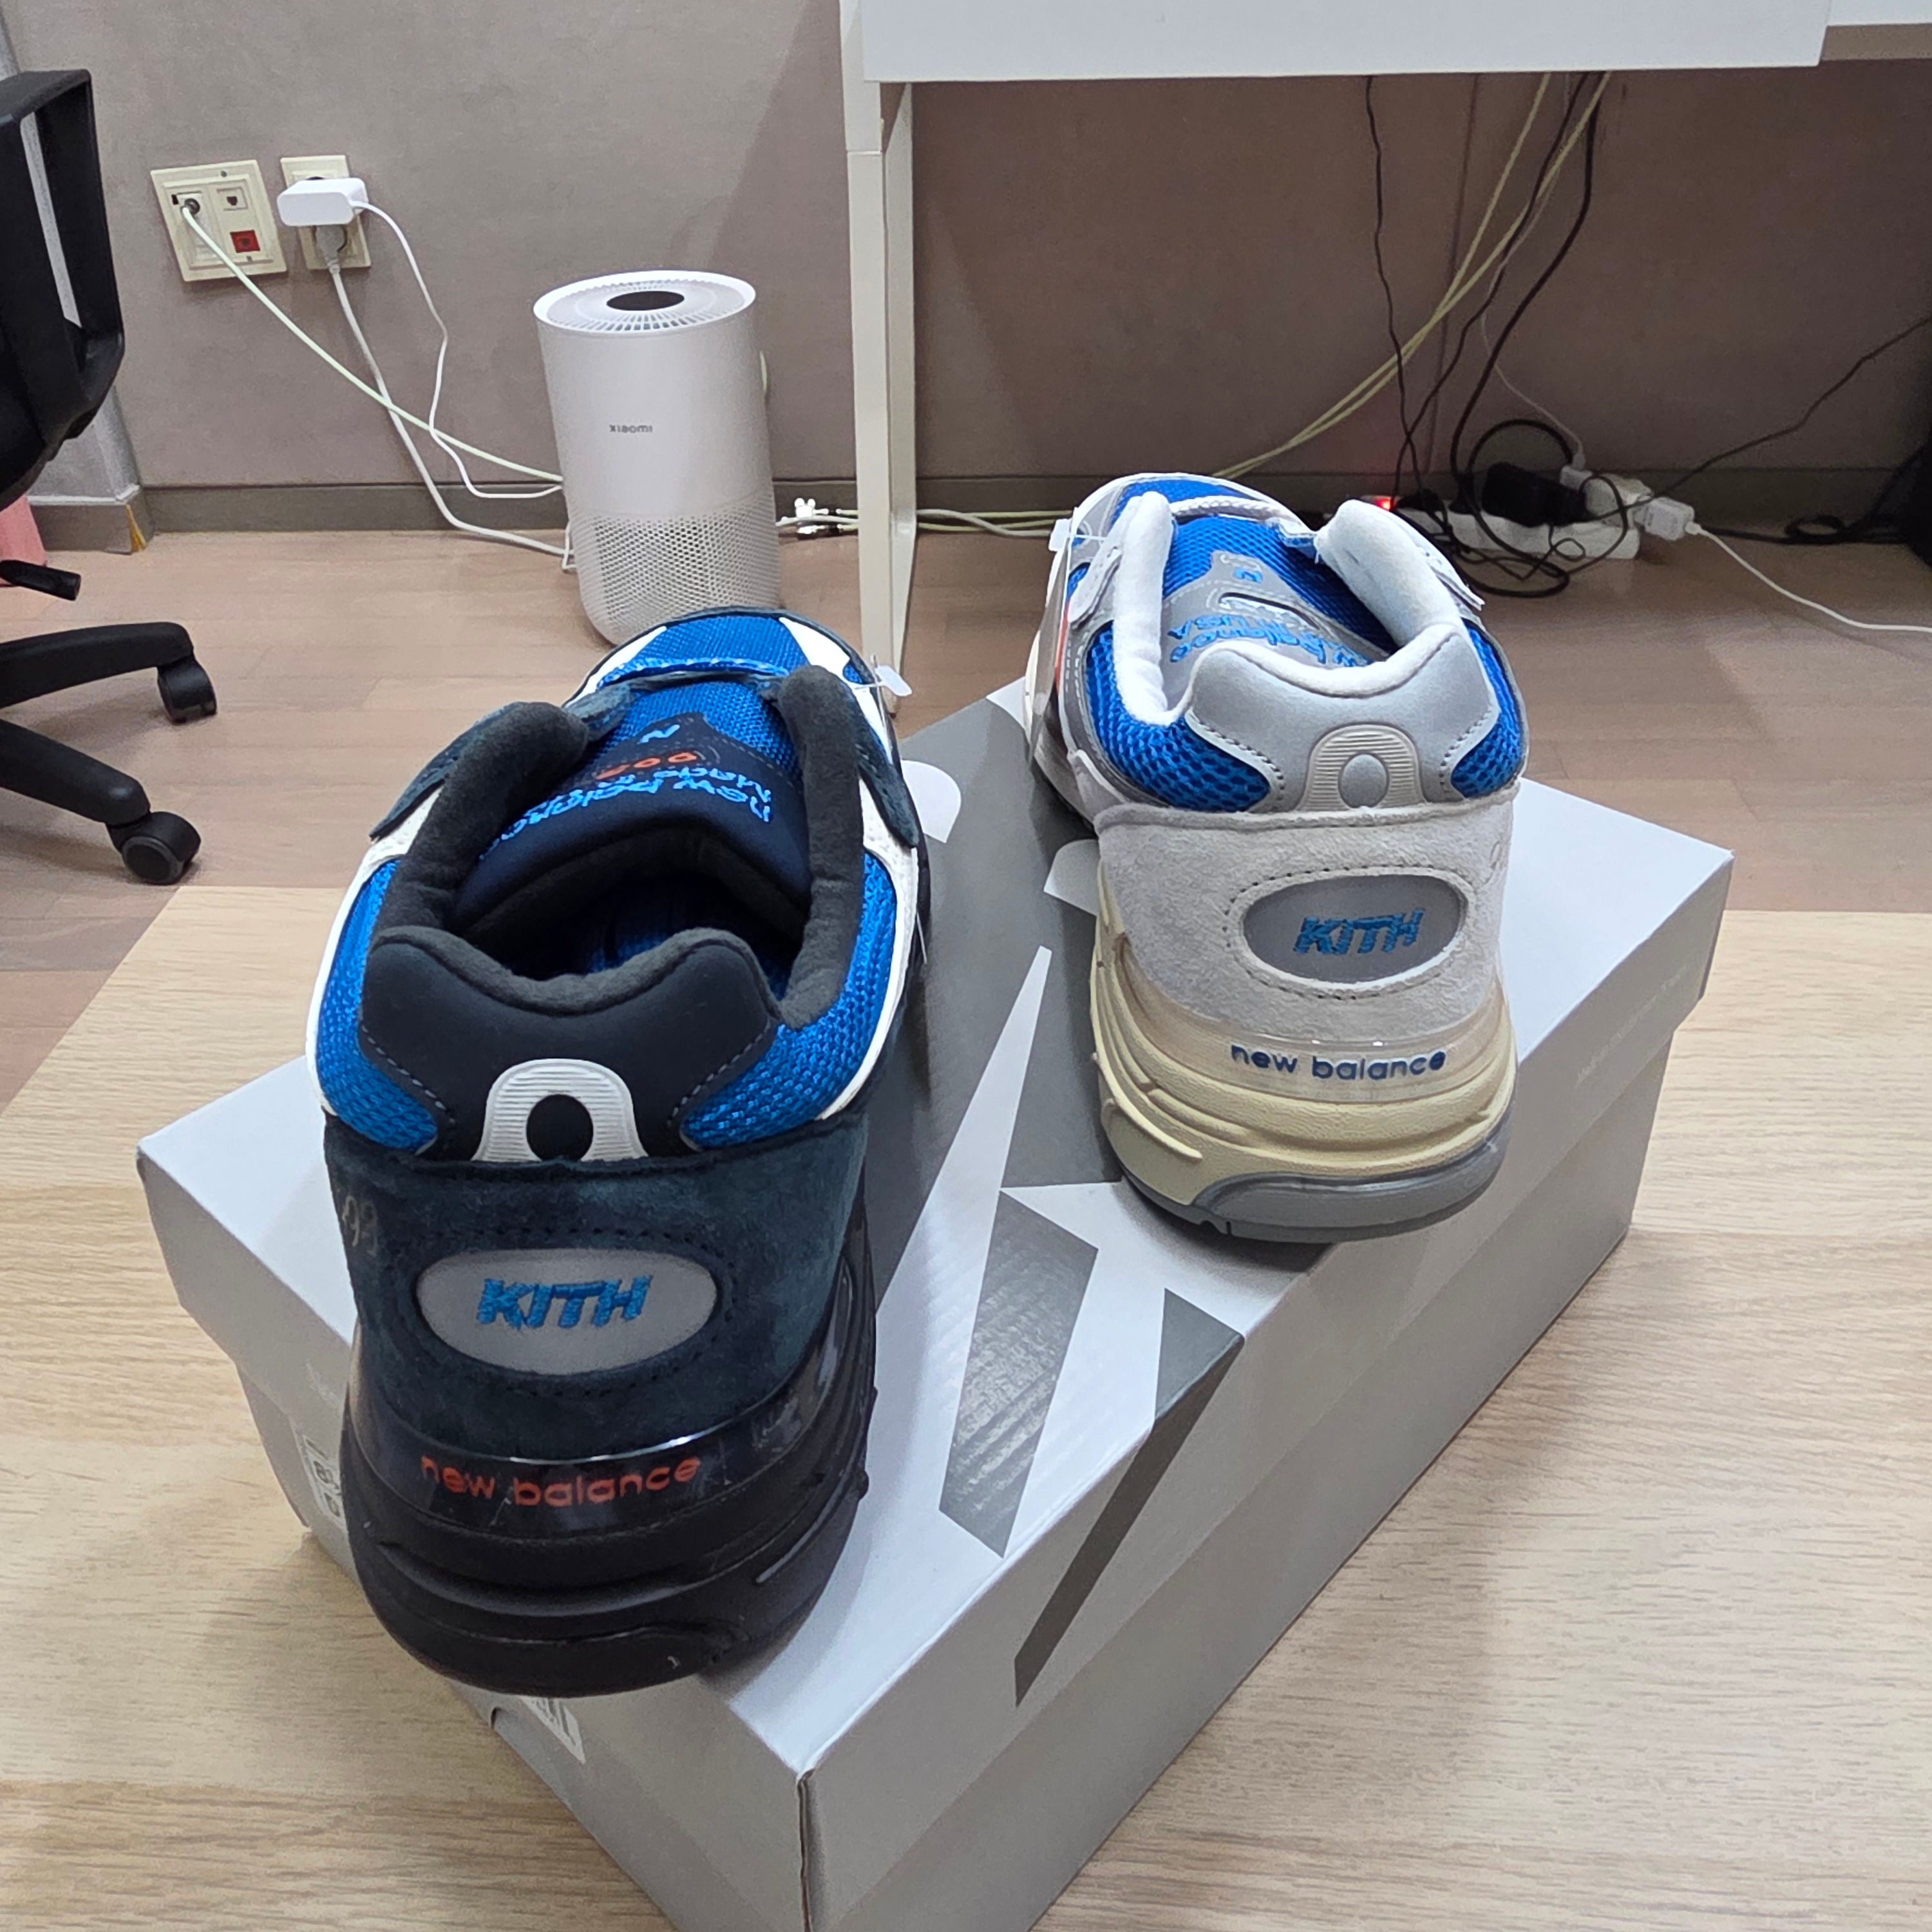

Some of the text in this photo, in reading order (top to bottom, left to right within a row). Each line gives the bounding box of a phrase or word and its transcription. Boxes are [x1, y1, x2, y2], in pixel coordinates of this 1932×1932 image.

[609, 424, 653, 433] xiaomi
[1293, 909, 1425, 955] KITH
[1231, 1044, 1446, 1080] new balance
[476, 1275, 653, 1331] KITH
[421, 1455, 701, 1507] new balance
